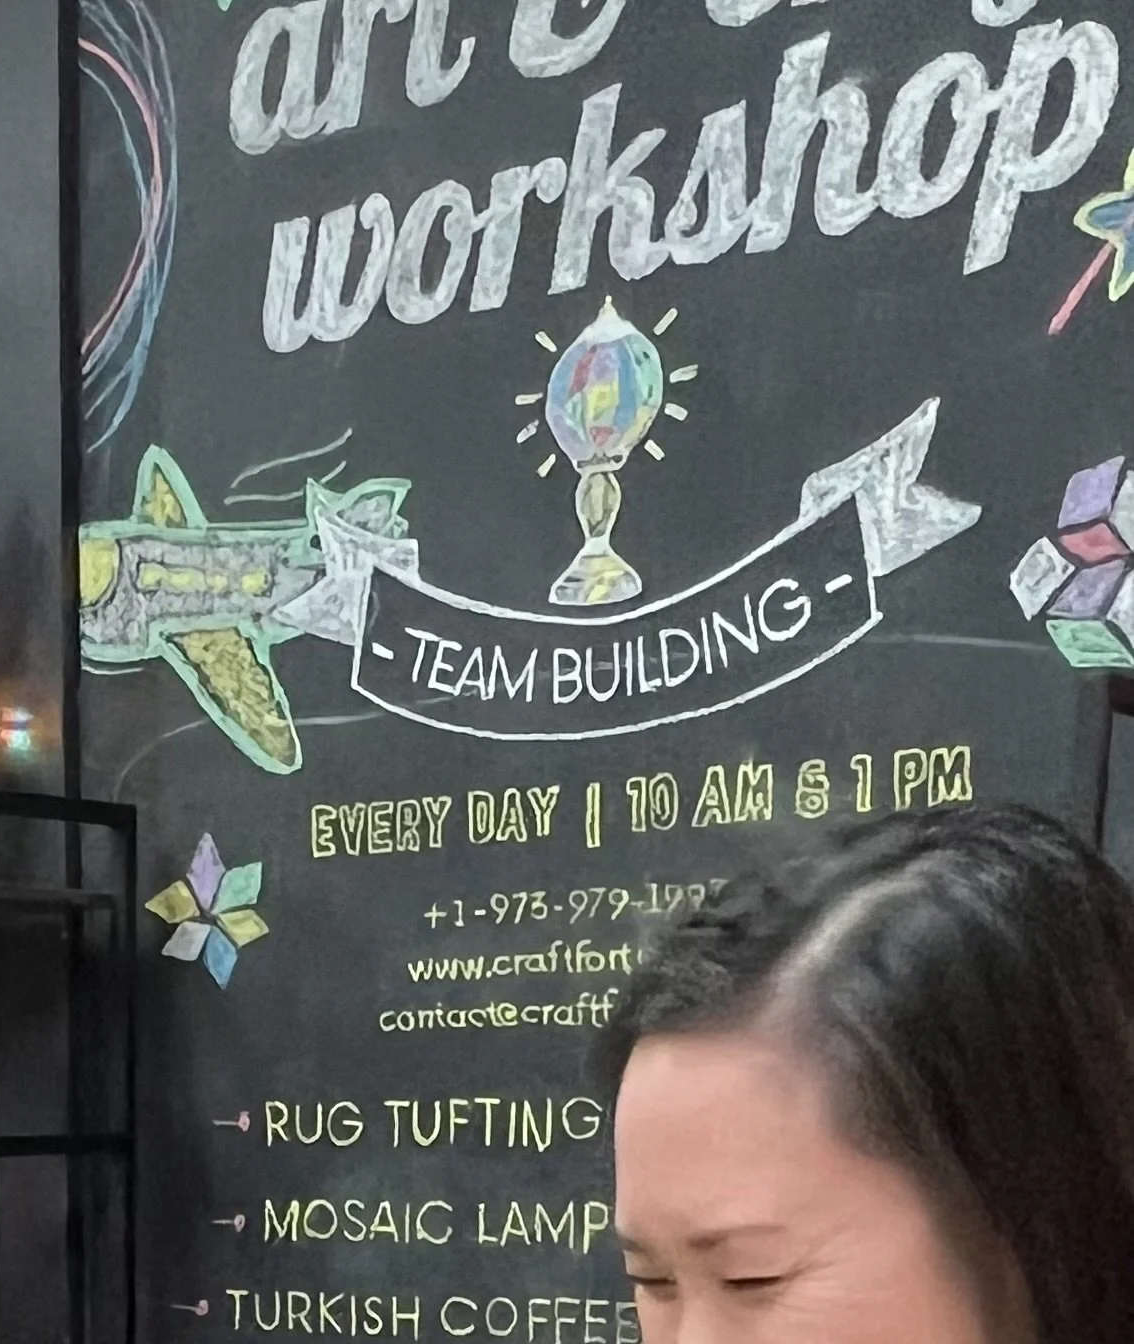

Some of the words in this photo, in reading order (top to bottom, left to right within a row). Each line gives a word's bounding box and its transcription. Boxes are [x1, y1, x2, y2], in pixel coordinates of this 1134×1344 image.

[264, 18, 1120, 355] workshop
[403, 626, 539, 703] TEAM
[552, 577, 812, 705] BUILDING
[311, 796, 452, 858] EVERY
[467, 784, 560, 845] DAY
[626, 772, 679, 833] 10
[692, 761, 774, 829] AM
[850, 753, 873, 813] 1
[893, 745, 973, 812] PM
[406, 938, 643, 983] www.craftfort
[264, 1099, 365, 1148] RUG
[384, 1096, 604, 1152] TUFTING
[263, 1198, 454, 1245] MOSAIC
[478, 1200, 610, 1255] LAMP
[226, 1288, 421, 1341] TURKISH
